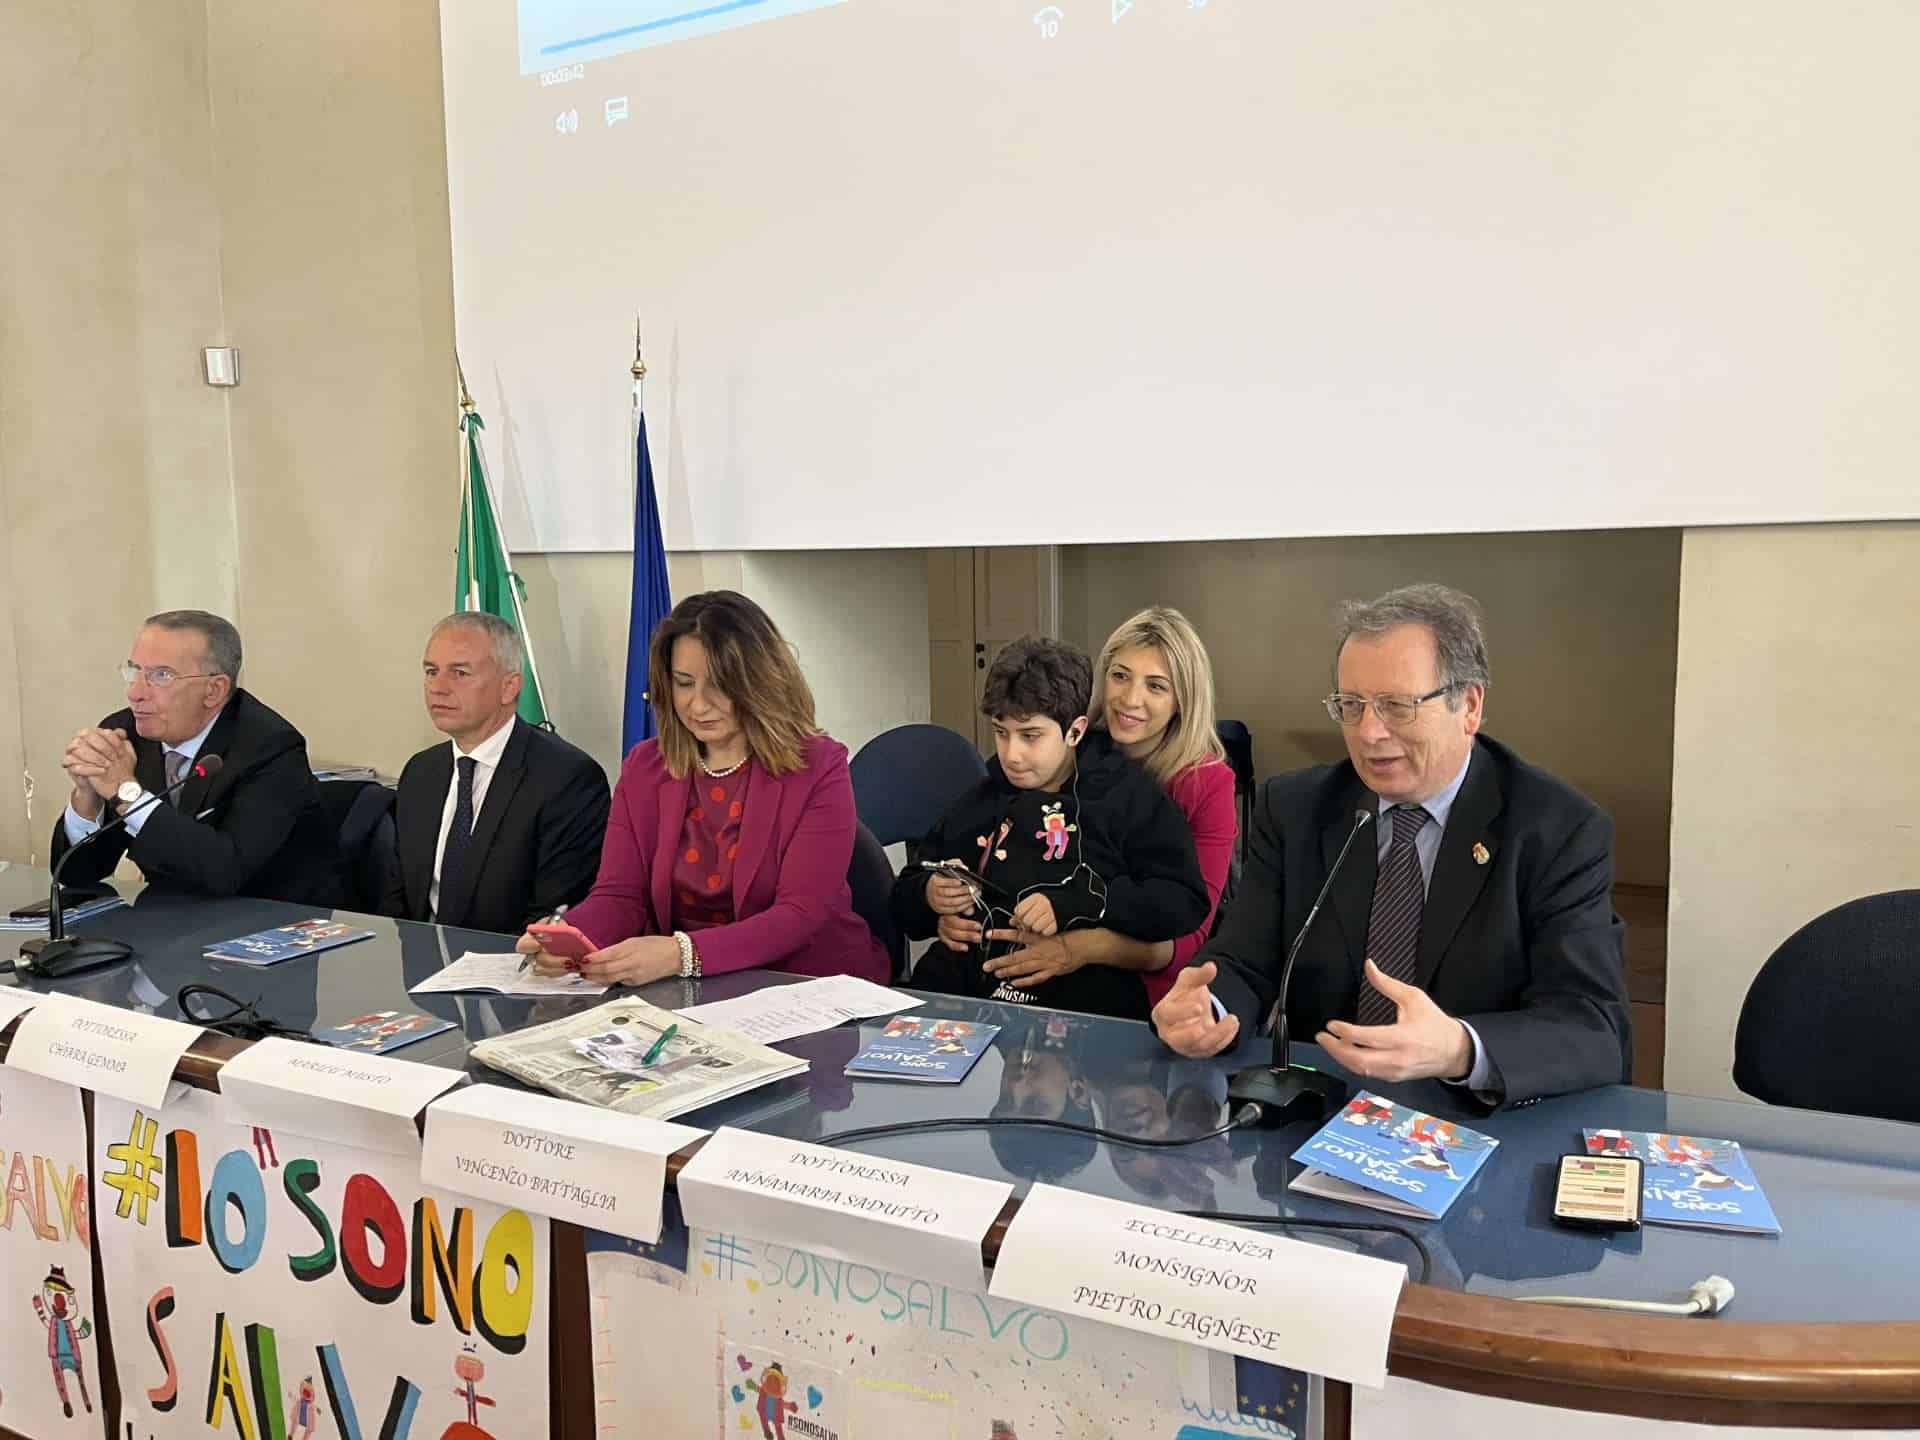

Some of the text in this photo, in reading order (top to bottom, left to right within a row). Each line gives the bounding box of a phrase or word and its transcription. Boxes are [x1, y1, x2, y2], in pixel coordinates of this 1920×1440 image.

[1040, 21, 1059, 40] 10
[503, 1130, 576, 1160] DOTTORE
[1311, 1139, 1402, 1176] SALVO!
[455, 1155, 617, 1212] VINCENZO BATTAGLIA
[788, 1151, 911, 1187] DOTTORESSA
[1361, 1167, 1427, 1193] SONO
[725, 1167, 940, 1225] ANNAMARIA SADUTTO
[1671, 1200, 1743, 1214] SONO
[1123, 1218, 1275, 1261] ECCELLENZA
[1113, 1250, 1258, 1296] MONSIGNOR
[1073, 1285, 1280, 1351] PIETRO LAGNESE
